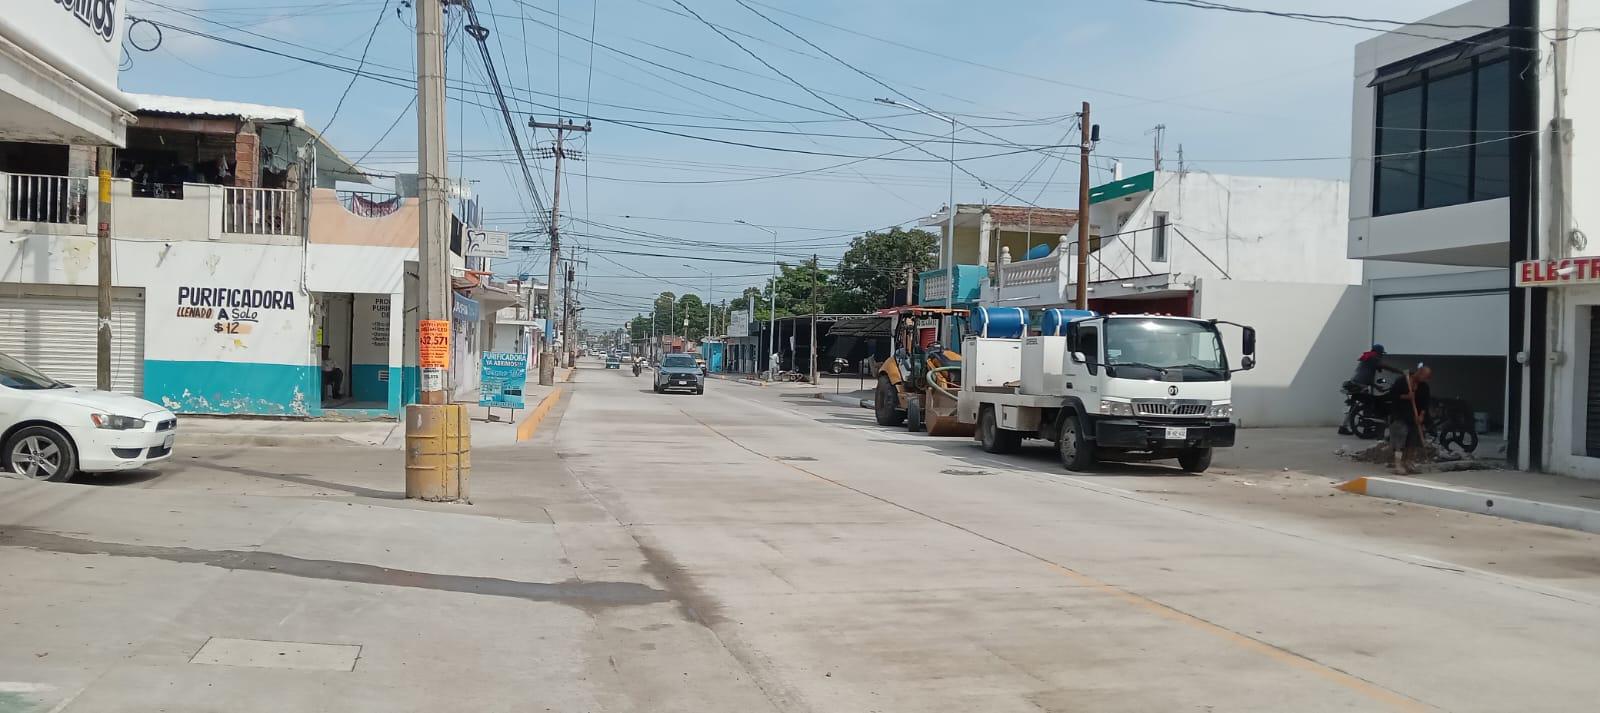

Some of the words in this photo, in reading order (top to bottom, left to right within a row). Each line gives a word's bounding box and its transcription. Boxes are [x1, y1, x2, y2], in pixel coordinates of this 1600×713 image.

[178, 287, 295, 310] PURIFICADORA
[176, 307, 213, 319] LLENADO
[217, 308, 229, 320] A
[483, 351, 527, 361] PURIFICADORA
